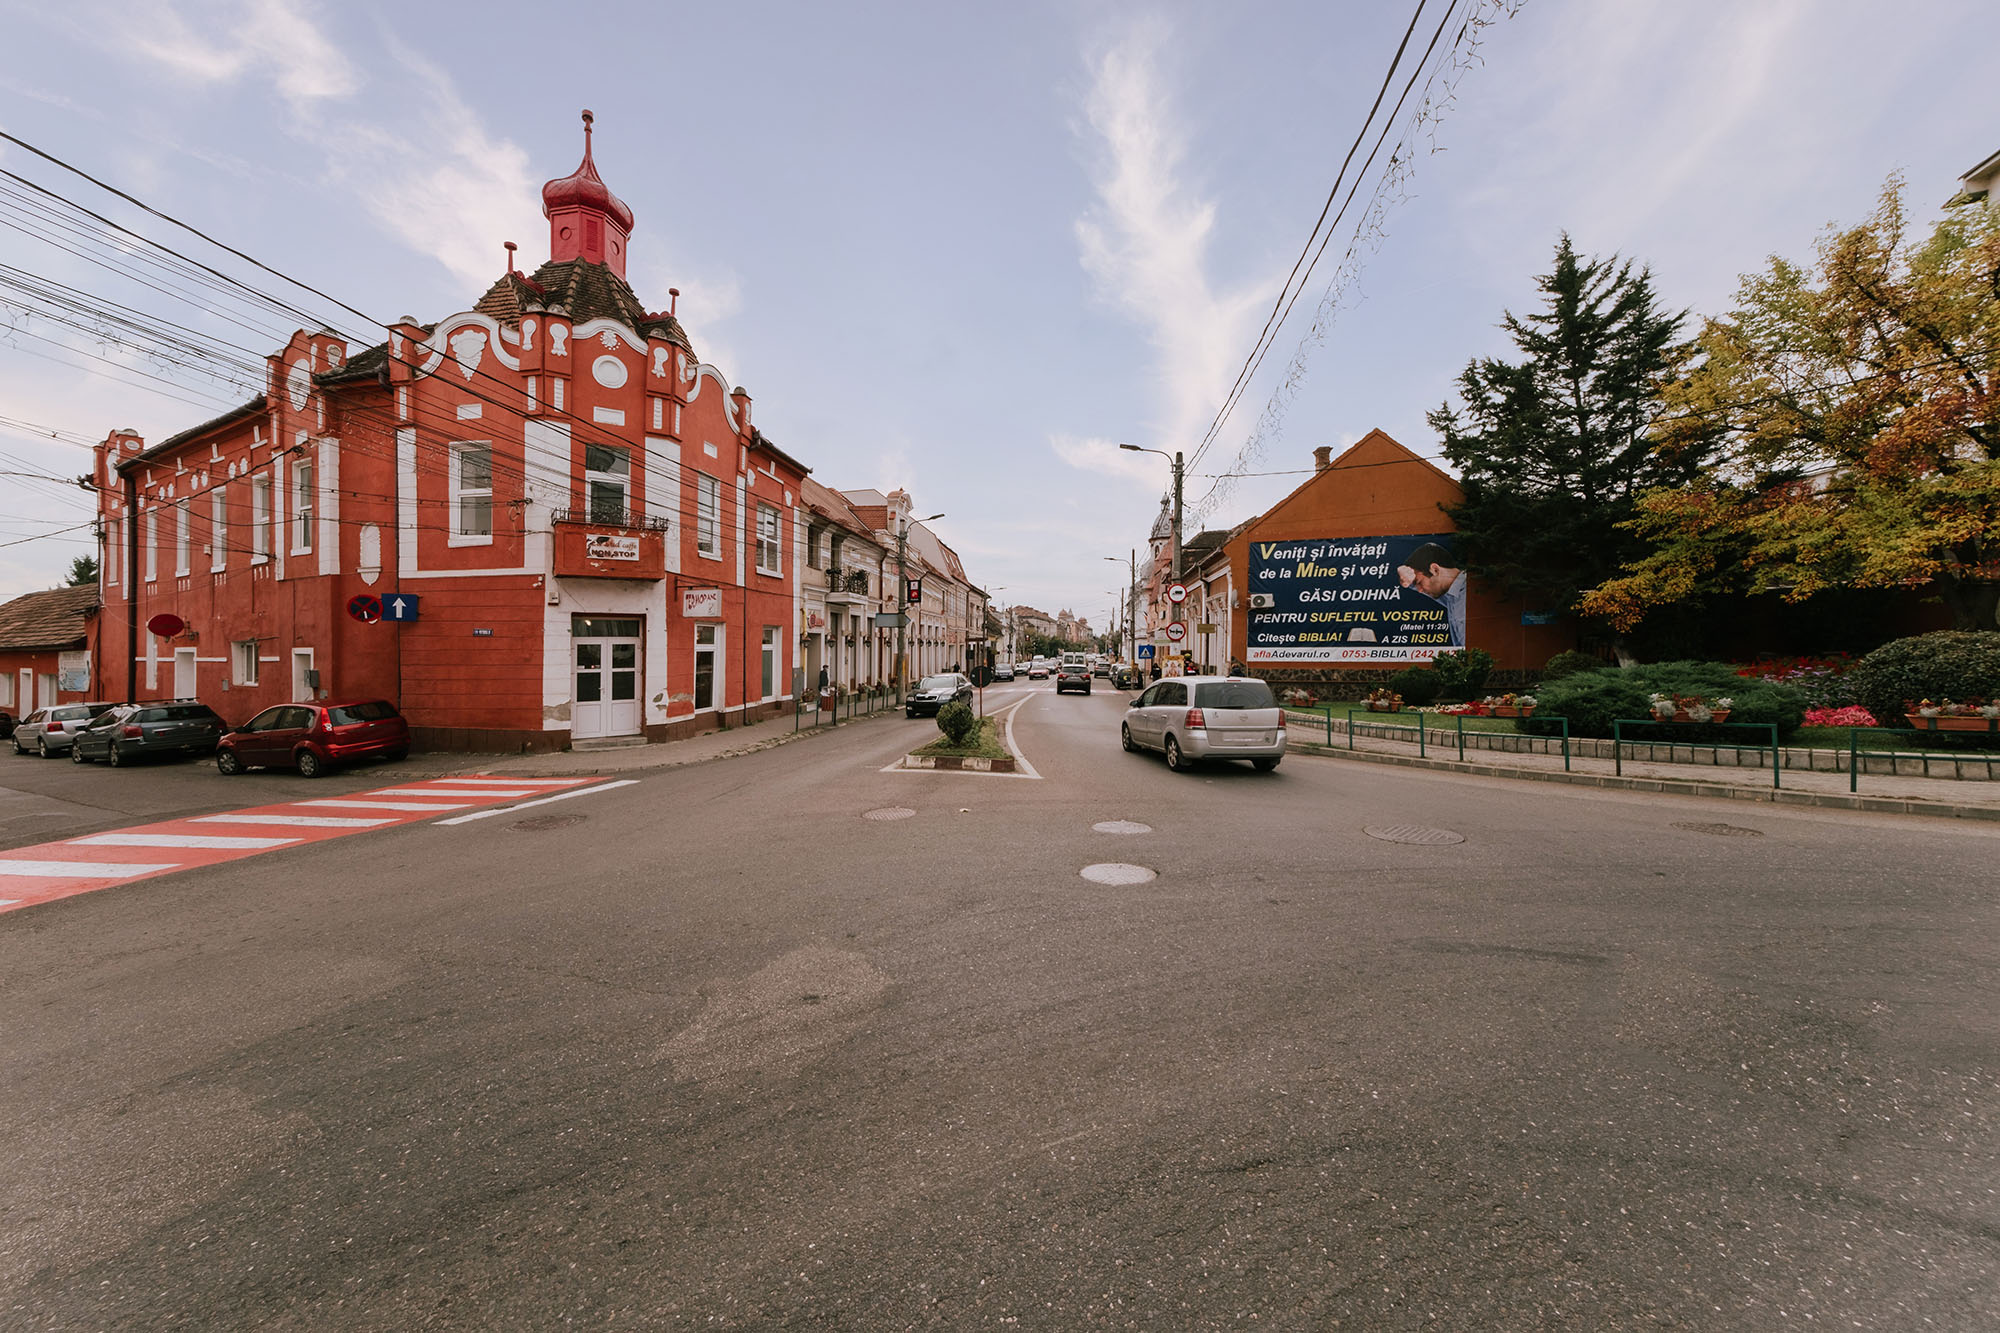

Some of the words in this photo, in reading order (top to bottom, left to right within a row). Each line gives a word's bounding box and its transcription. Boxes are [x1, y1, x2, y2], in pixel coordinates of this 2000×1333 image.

[613, 550, 636, 558] STOP
[1260, 543, 1307, 562] Veniți
[1310, 545, 1325, 562] și
[1328, 542, 1388, 560] învățați
[1259, 568, 1276, 579] de
[1279, 567, 1292, 578] la
[1295, 562, 1337, 578] Mine
[1340, 564, 1356, 580] și
[1360, 562, 1390, 579] veți
[1298, 588, 1336, 602] GĂSI
[1339, 585, 1400, 601] ODIHNĂ
[1254, 613, 1307, 623] PENTRU
[1309, 611, 1378, 623] SUFLETUL
[1382, 610, 1444, 621] VOSTRU!
[1257, 633, 1296, 644] Citește
[1298, 633, 1342, 642] BIBLIA!
[1381, 636, 1390, 644] A
[1391, 635, 1408, 644] ZIS
[1410, 633, 1449, 643] IISUS!
[1253, 650, 1330, 659] aflaAdevarul.ro
[1342, 650, 1408, 659] 0753-BIBLIA
